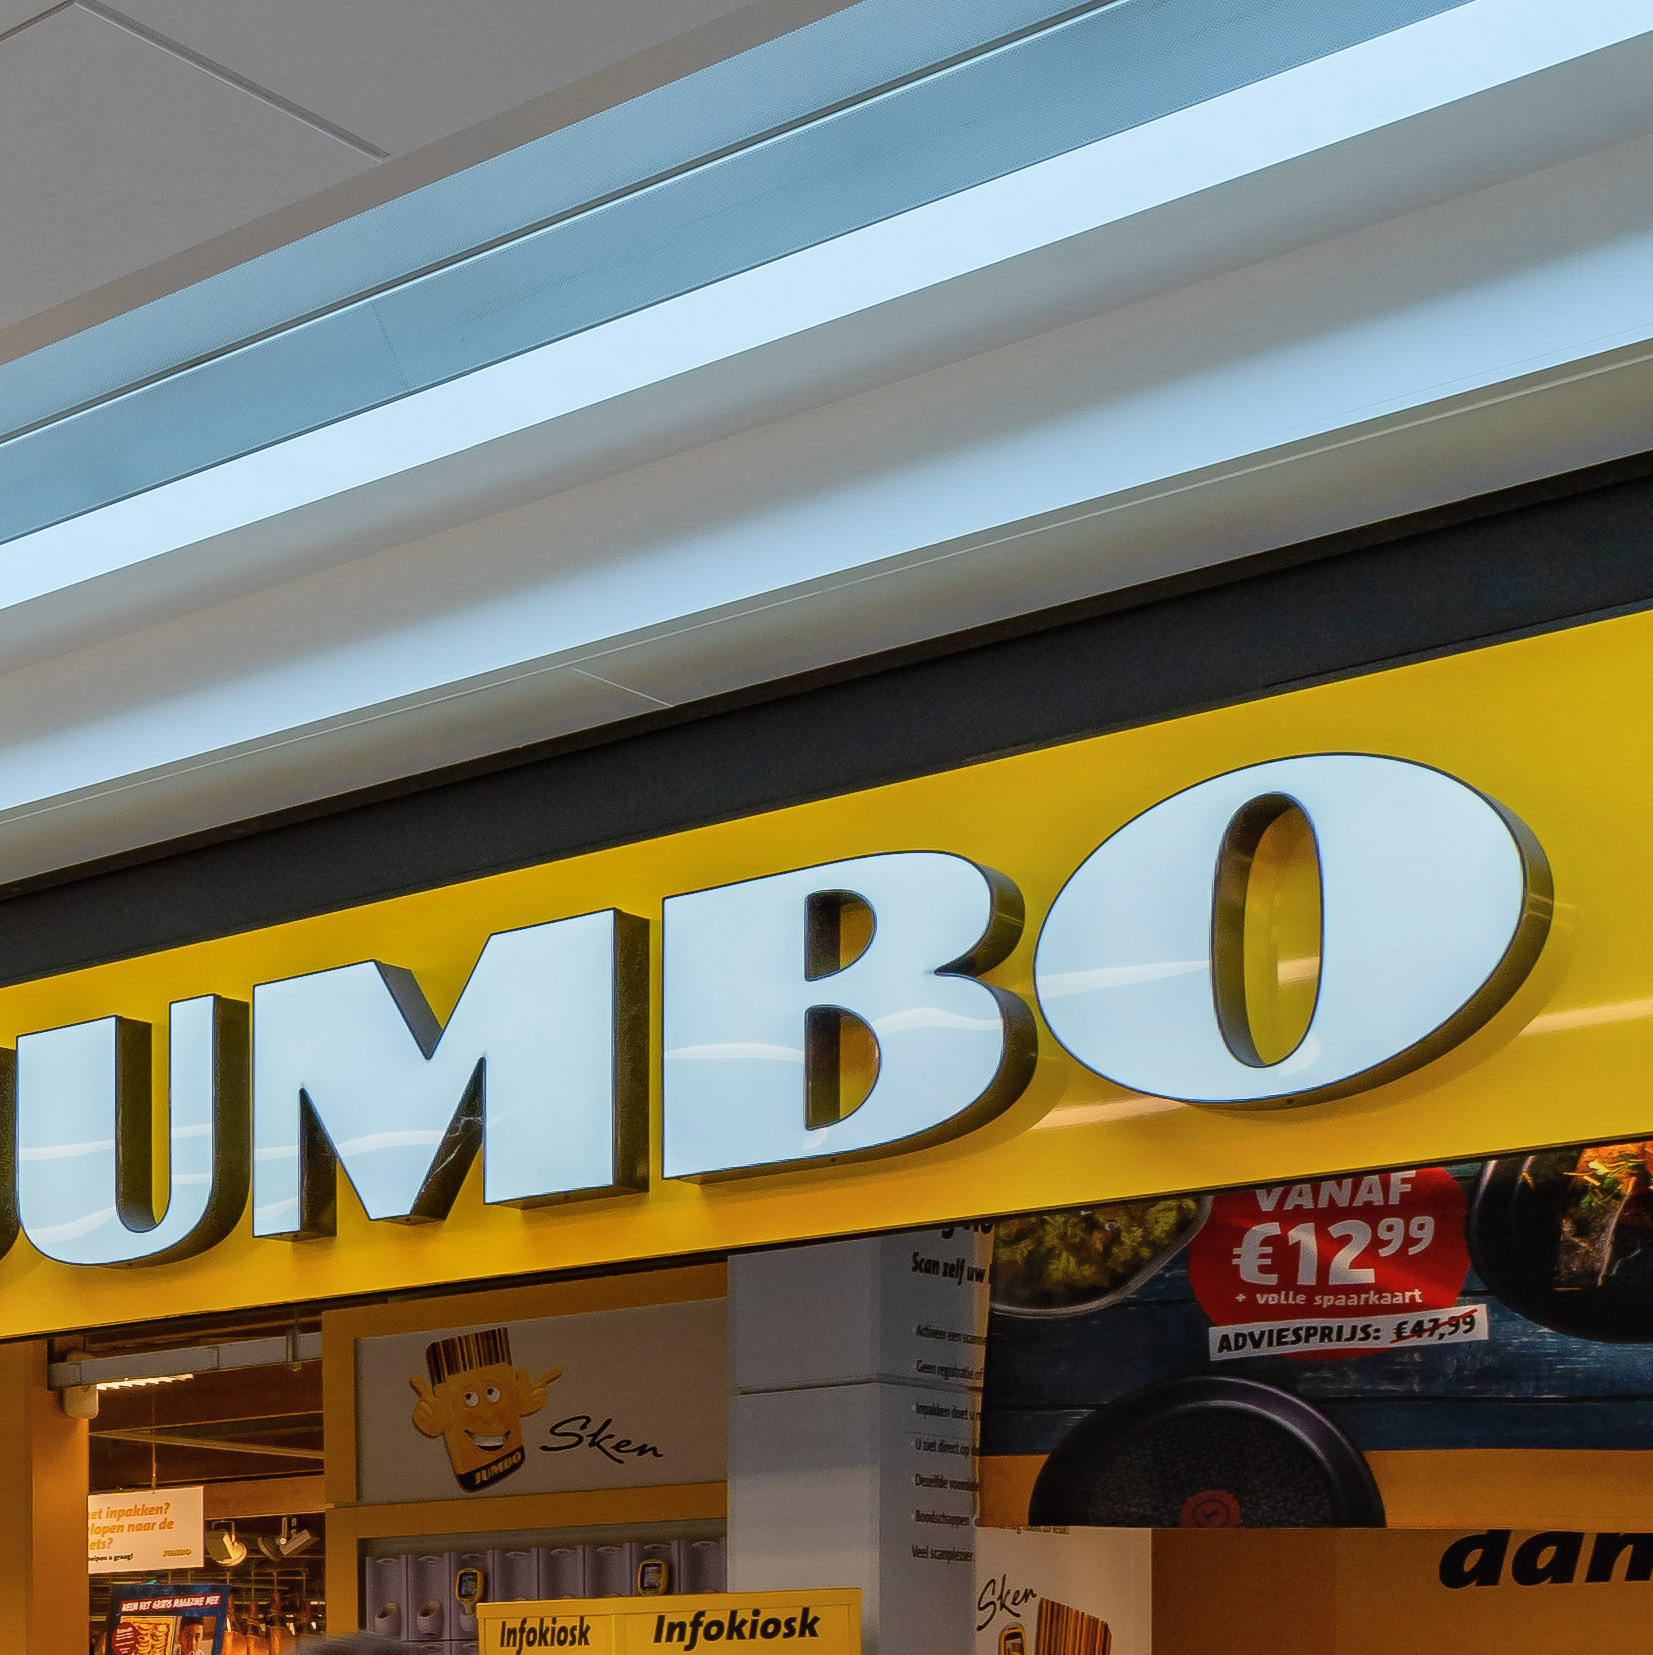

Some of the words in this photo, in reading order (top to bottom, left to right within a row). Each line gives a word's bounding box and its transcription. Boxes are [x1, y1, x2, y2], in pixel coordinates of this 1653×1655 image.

[1255, 1171, 1416, 1211] VANAF
[1232, 1216, 1435, 1285] €1299
[911, 1252, 939, 1276] Scan
[942, 1260, 965, 1287] zelf
[968, 1267, 986, 1283] uw
[1256, 1291, 1306, 1305] volle
[1314, 1289, 1423, 1308] spaarkaart
[1217, 1324, 1381, 1354] ADVIESPRIJS:
[539, 1415, 664, 1464] Sken
[474, 1451, 522, 1485] JUMBO
[89, 1523, 125, 1536] lopen
[128, 1521, 157, 1532] naar
[158, 1519, 174, 1530] de
[106, 1503, 170, 1518] inpakken?
[114, 1553, 133, 1562] graag!
[163, 1549, 191, 1558] JUMBO
[911, 1544, 929, 1559] Veel
[977, 1574, 1037, 1631] Sken
[500, 1616, 591, 1655] Infokiosk
[653, 1607, 822, 1651] Infokiosk
